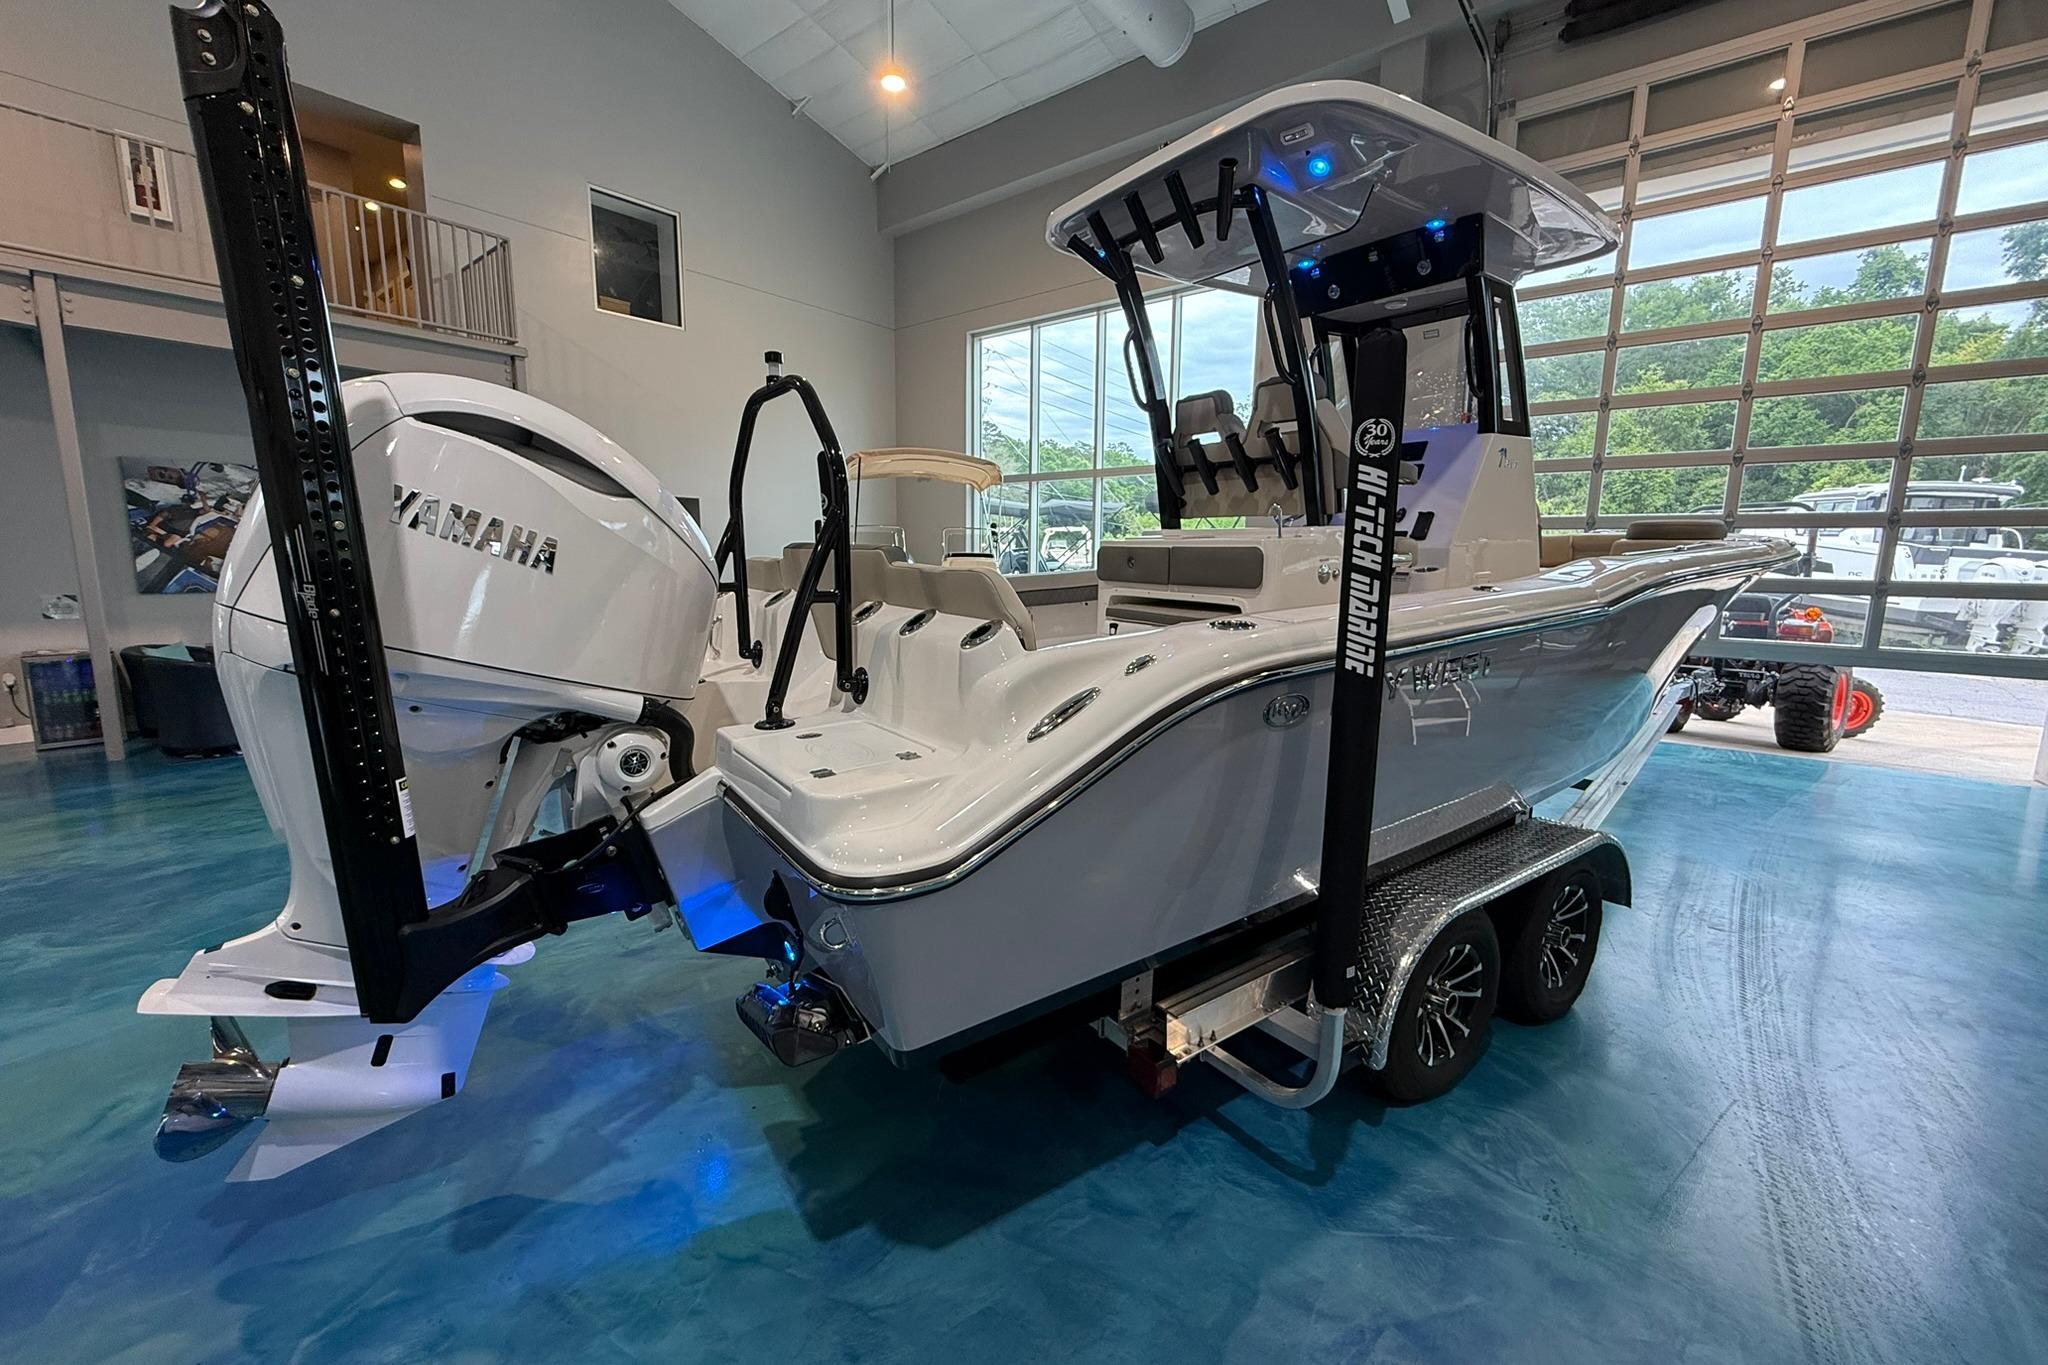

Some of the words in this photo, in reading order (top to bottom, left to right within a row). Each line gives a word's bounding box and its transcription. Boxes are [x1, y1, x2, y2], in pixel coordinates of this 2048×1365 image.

[1364, 434, 1389, 450] Years
[1366, 424, 1388, 437] 30
[389, 483, 558, 576] YAMAHA
[1352, 463, 1388, 572] HI-TECH
[298, 583, 320, 619] Blade
[1412, 649, 1496, 693] WEST
